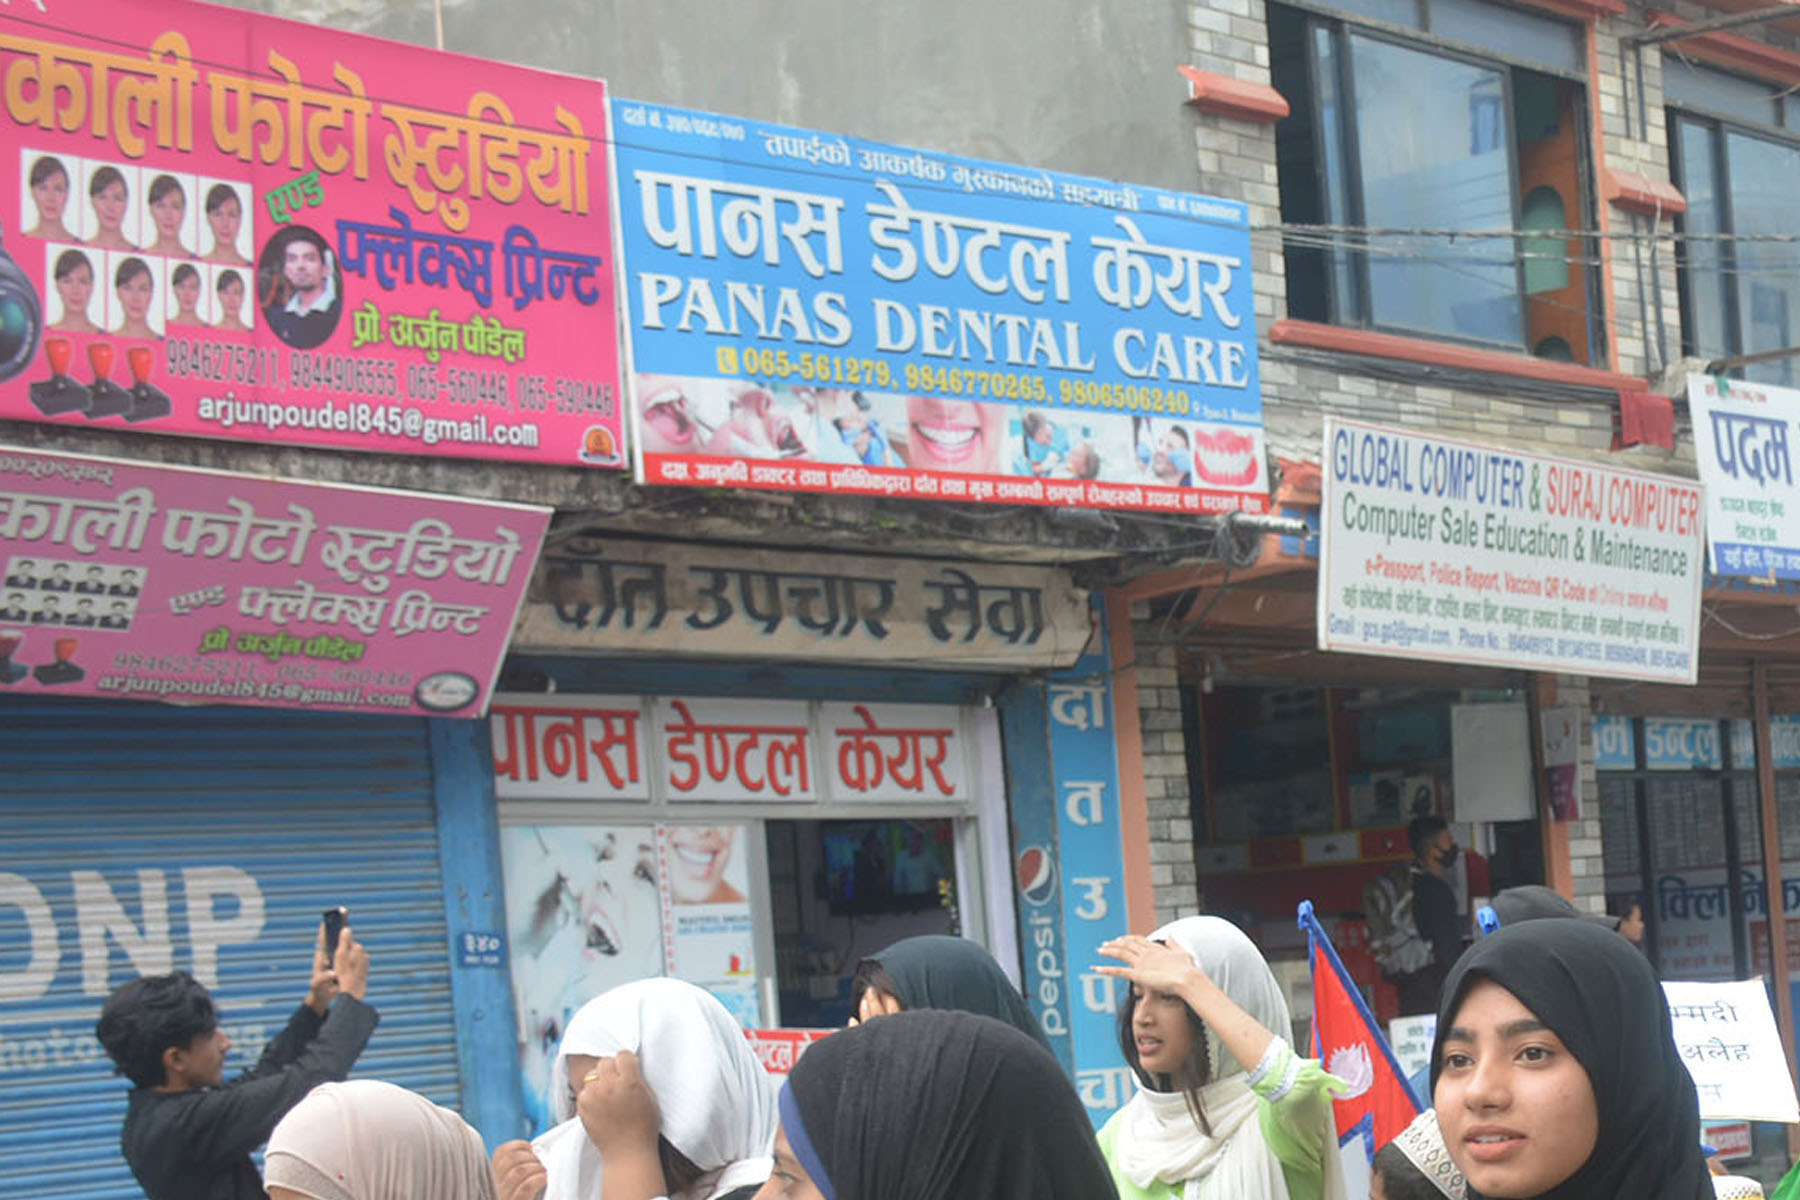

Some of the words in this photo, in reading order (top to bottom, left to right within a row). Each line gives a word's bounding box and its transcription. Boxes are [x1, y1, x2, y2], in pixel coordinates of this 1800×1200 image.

[0, 31, 199, 158] काली
[207, 48, 372, 180] फोटो
[382, 92, 592, 232] स्टुडियो
[264, 170, 326, 224] एण्ड
[335, 206, 496, 307] फ्लेक्स
[503, 225, 602, 310] प्रिन्ट
[634, 170, 843, 277] पानस
[865, 178, 1072, 302] डेण्टल
[1091, 215, 1241, 329] केयर
[388, 309, 459, 362] अर्जुन
[462, 314, 526, 363] पौडेल
[637, 271, 852, 347] PANAS
[873, 298, 1097, 373] DENTAL
[1112, 326, 1250, 389] CARE
[199, 392, 539, 447] arjunpoudel845@gmail.com
[1708, 410, 1793, 487] पदम
[1333, 428, 1413, 493] GLOBAL
[1419, 443, 1525, 509] COMPUTER
[1528, 463, 1542, 512] &
[1546, 465, 1603, 523] SURAJ
[1608, 477, 1700, 538] COMPUTER
[0, 487, 157, 556] काली
[162, 497, 318, 567] फोटो
[320, 519, 523, 594] स्टुडियो
[1342, 490, 1436, 545] Computer
[1440, 506, 1478, 548] Sale
[1483, 514, 1569, 561] Education
[1573, 526, 1585, 564] &
[1590, 532, 1688, 577] Maintenance
[389, 589, 490, 636] प्रिन्ट
[685, 563, 899, 640] उपचार
[923, 567, 1045, 646] सेवा
[664, 698, 810, 797] डेण्टल
[835, 704, 956, 796] केयर
[1029, 914, 1067, 1036] pepsi
